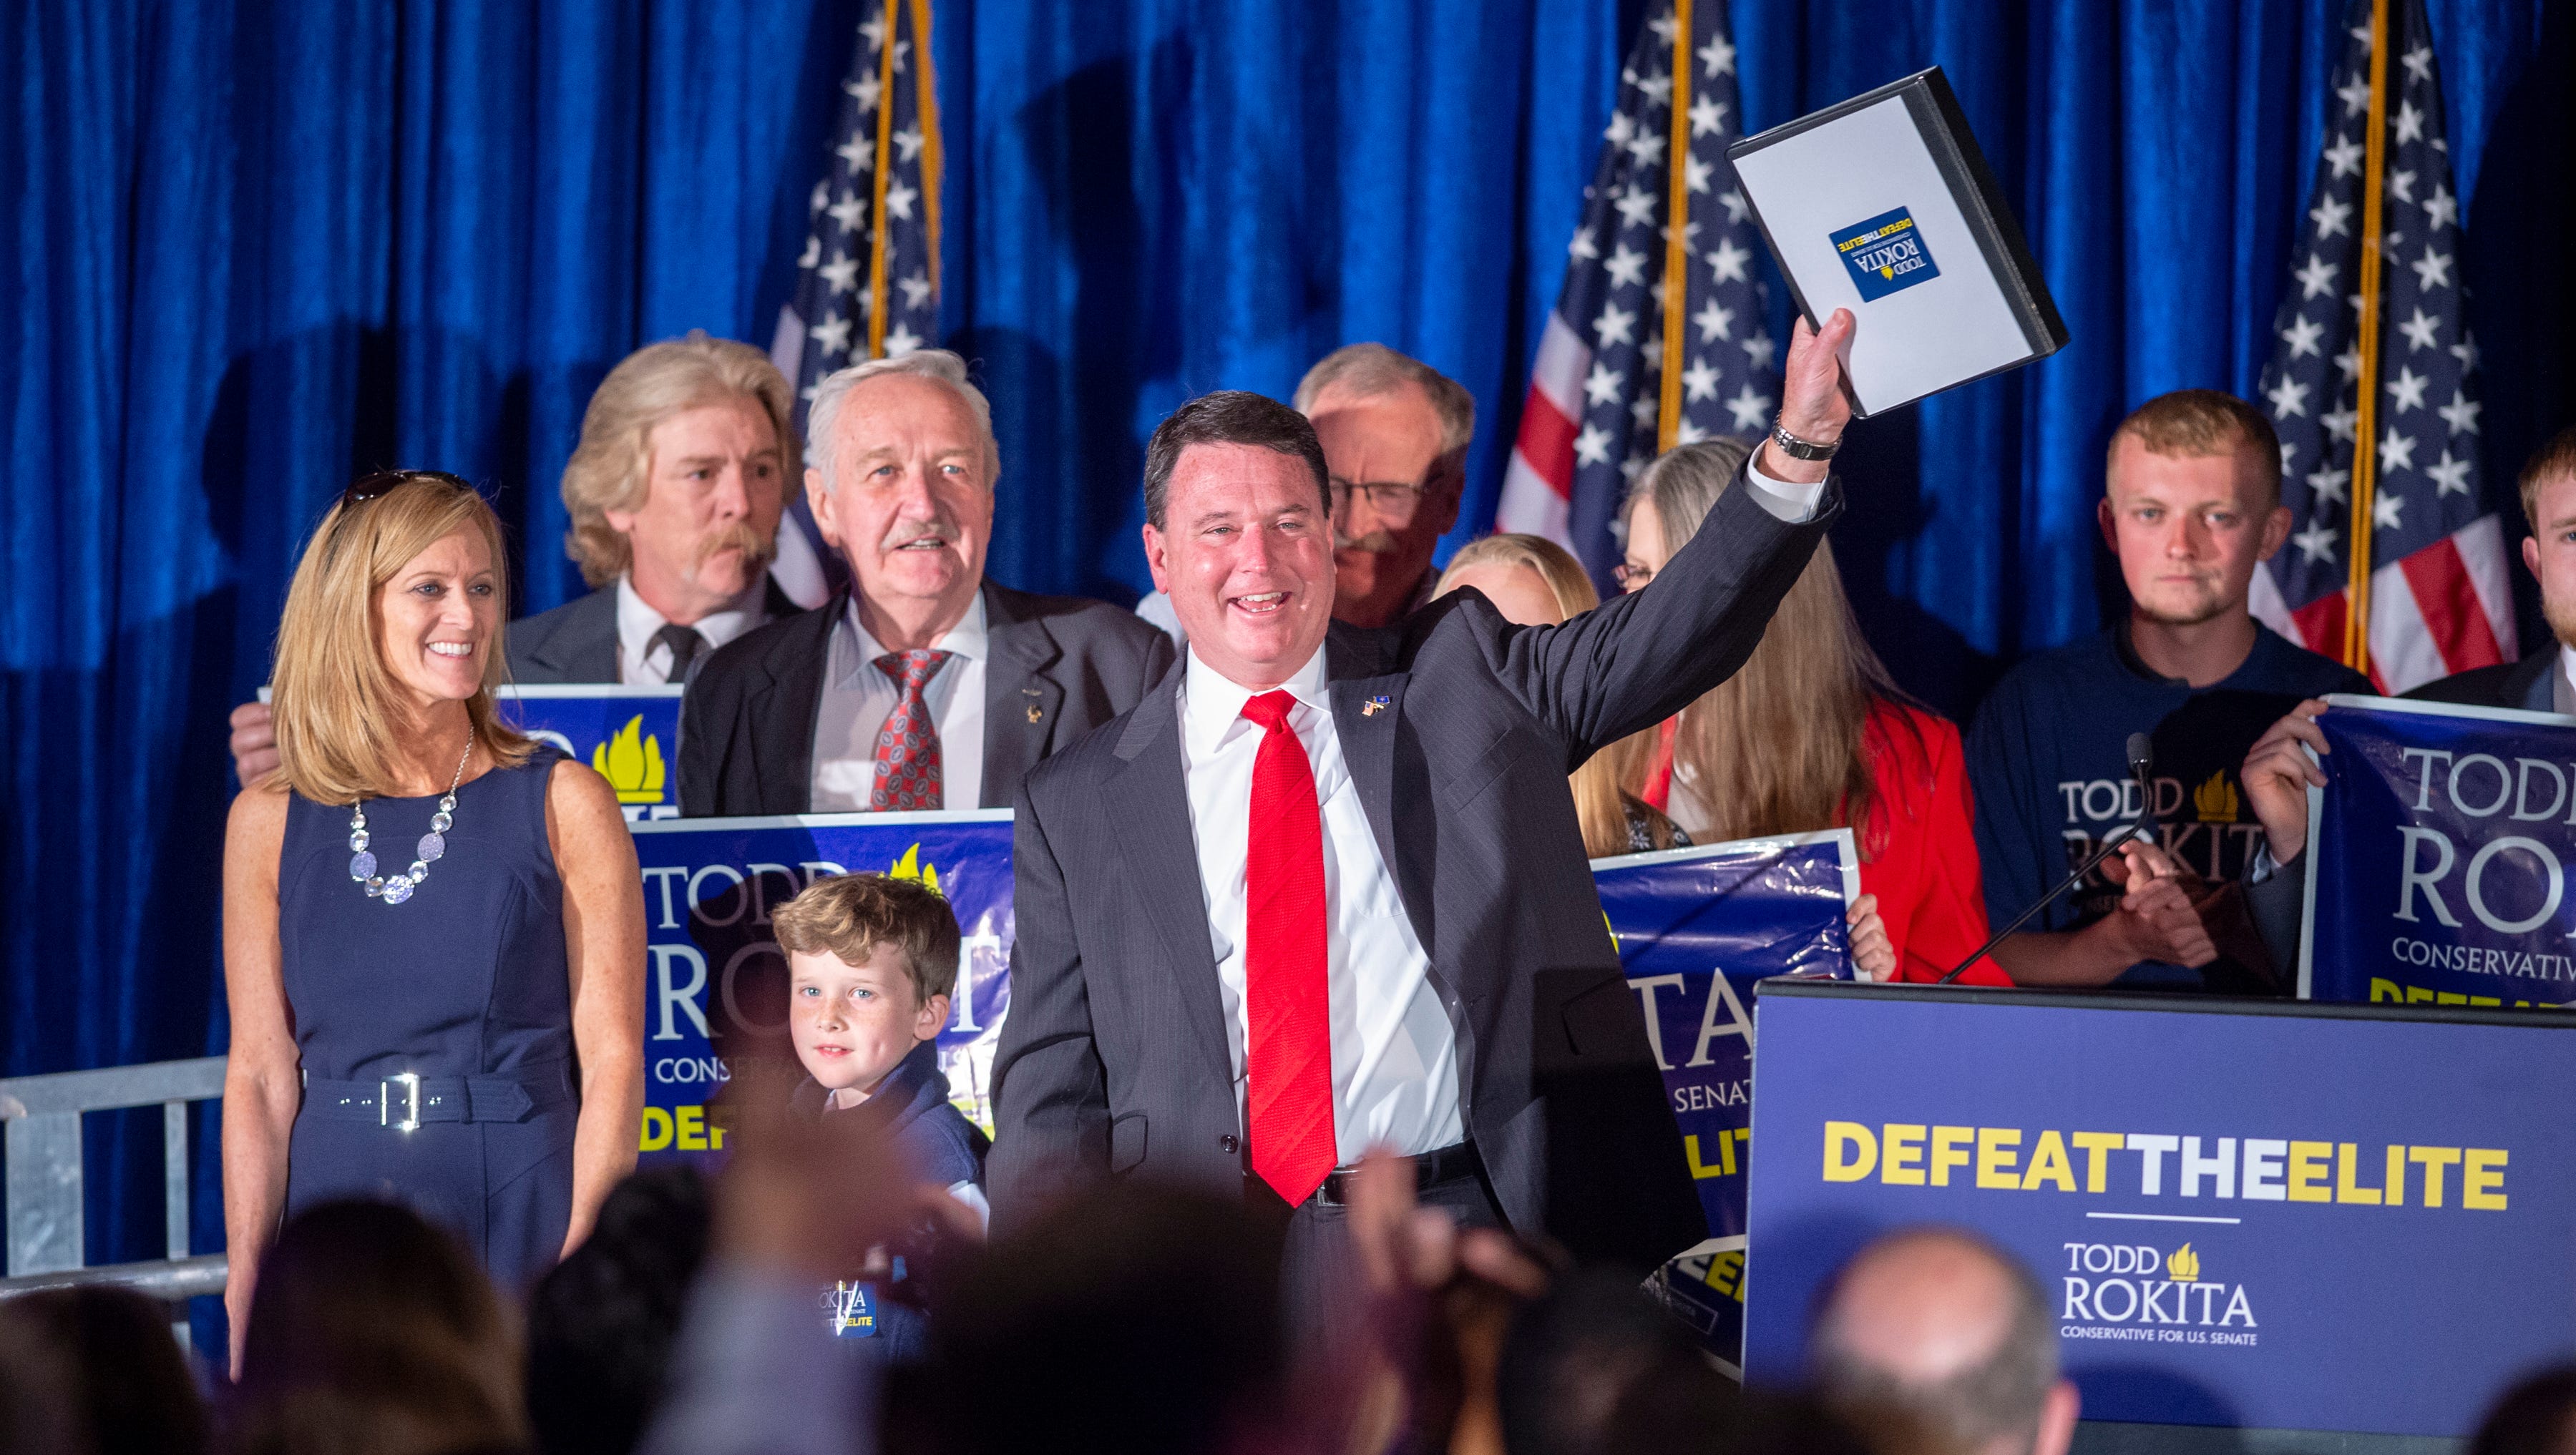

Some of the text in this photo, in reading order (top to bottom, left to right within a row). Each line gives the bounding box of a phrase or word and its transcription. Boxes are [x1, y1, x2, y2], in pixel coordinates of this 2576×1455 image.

[1854, 238, 1920, 273] ROKITA
[1893, 256, 1926, 275] TODD
[2058, 777, 2183, 823] TODD
[2403, 747, 2576, 825] TOD
[641, 861, 848, 929] TOD
[2393, 936, 2576, 982] CONSERVATIV
[2064, 1243, 2160, 1275] TODD
[2061, 1277, 2258, 1328] ROKITA
[2061, 1326, 2258, 1346] CONSERVATIVE FOR U.S. SENATE
